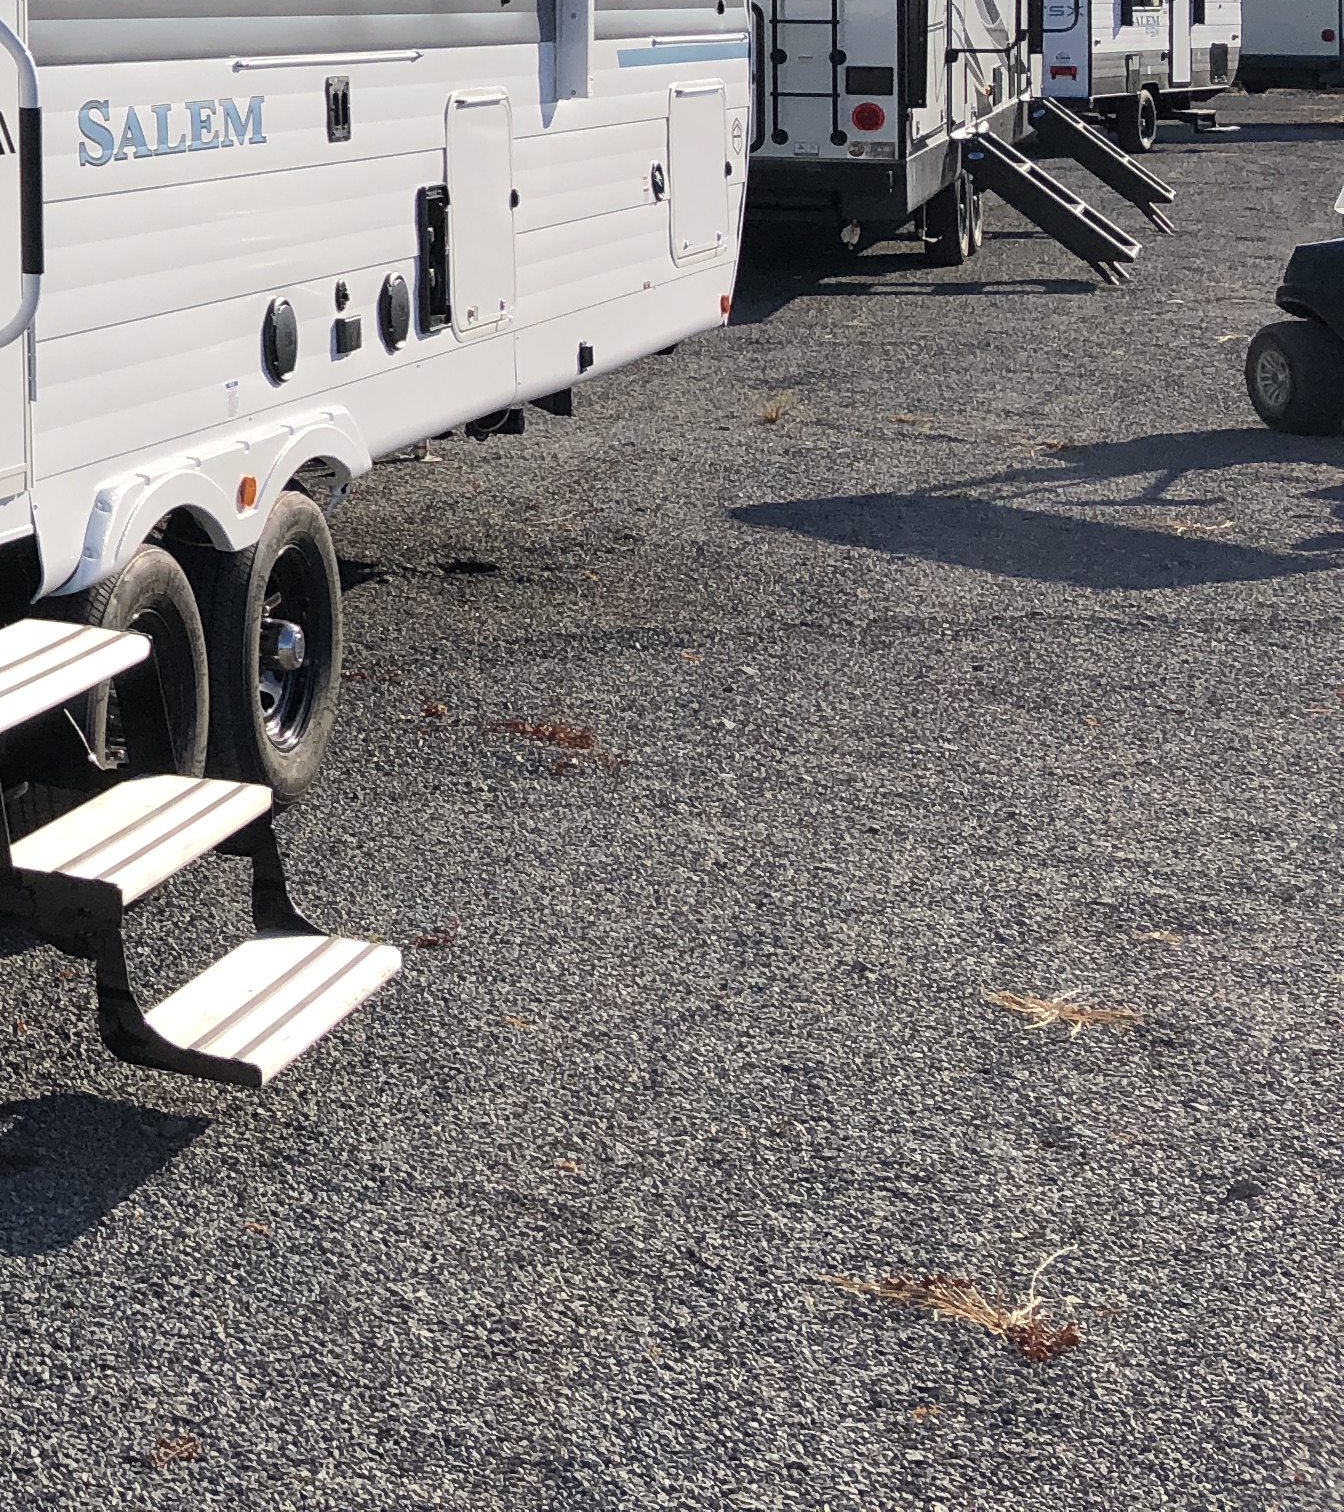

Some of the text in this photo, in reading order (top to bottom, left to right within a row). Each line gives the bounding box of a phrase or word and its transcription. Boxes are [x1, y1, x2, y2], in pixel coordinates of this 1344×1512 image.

[1044, 5, 1084, 17] SX
[1133, 15, 1161, 26] ALEM
[77, 95, 267, 167] SALEM
